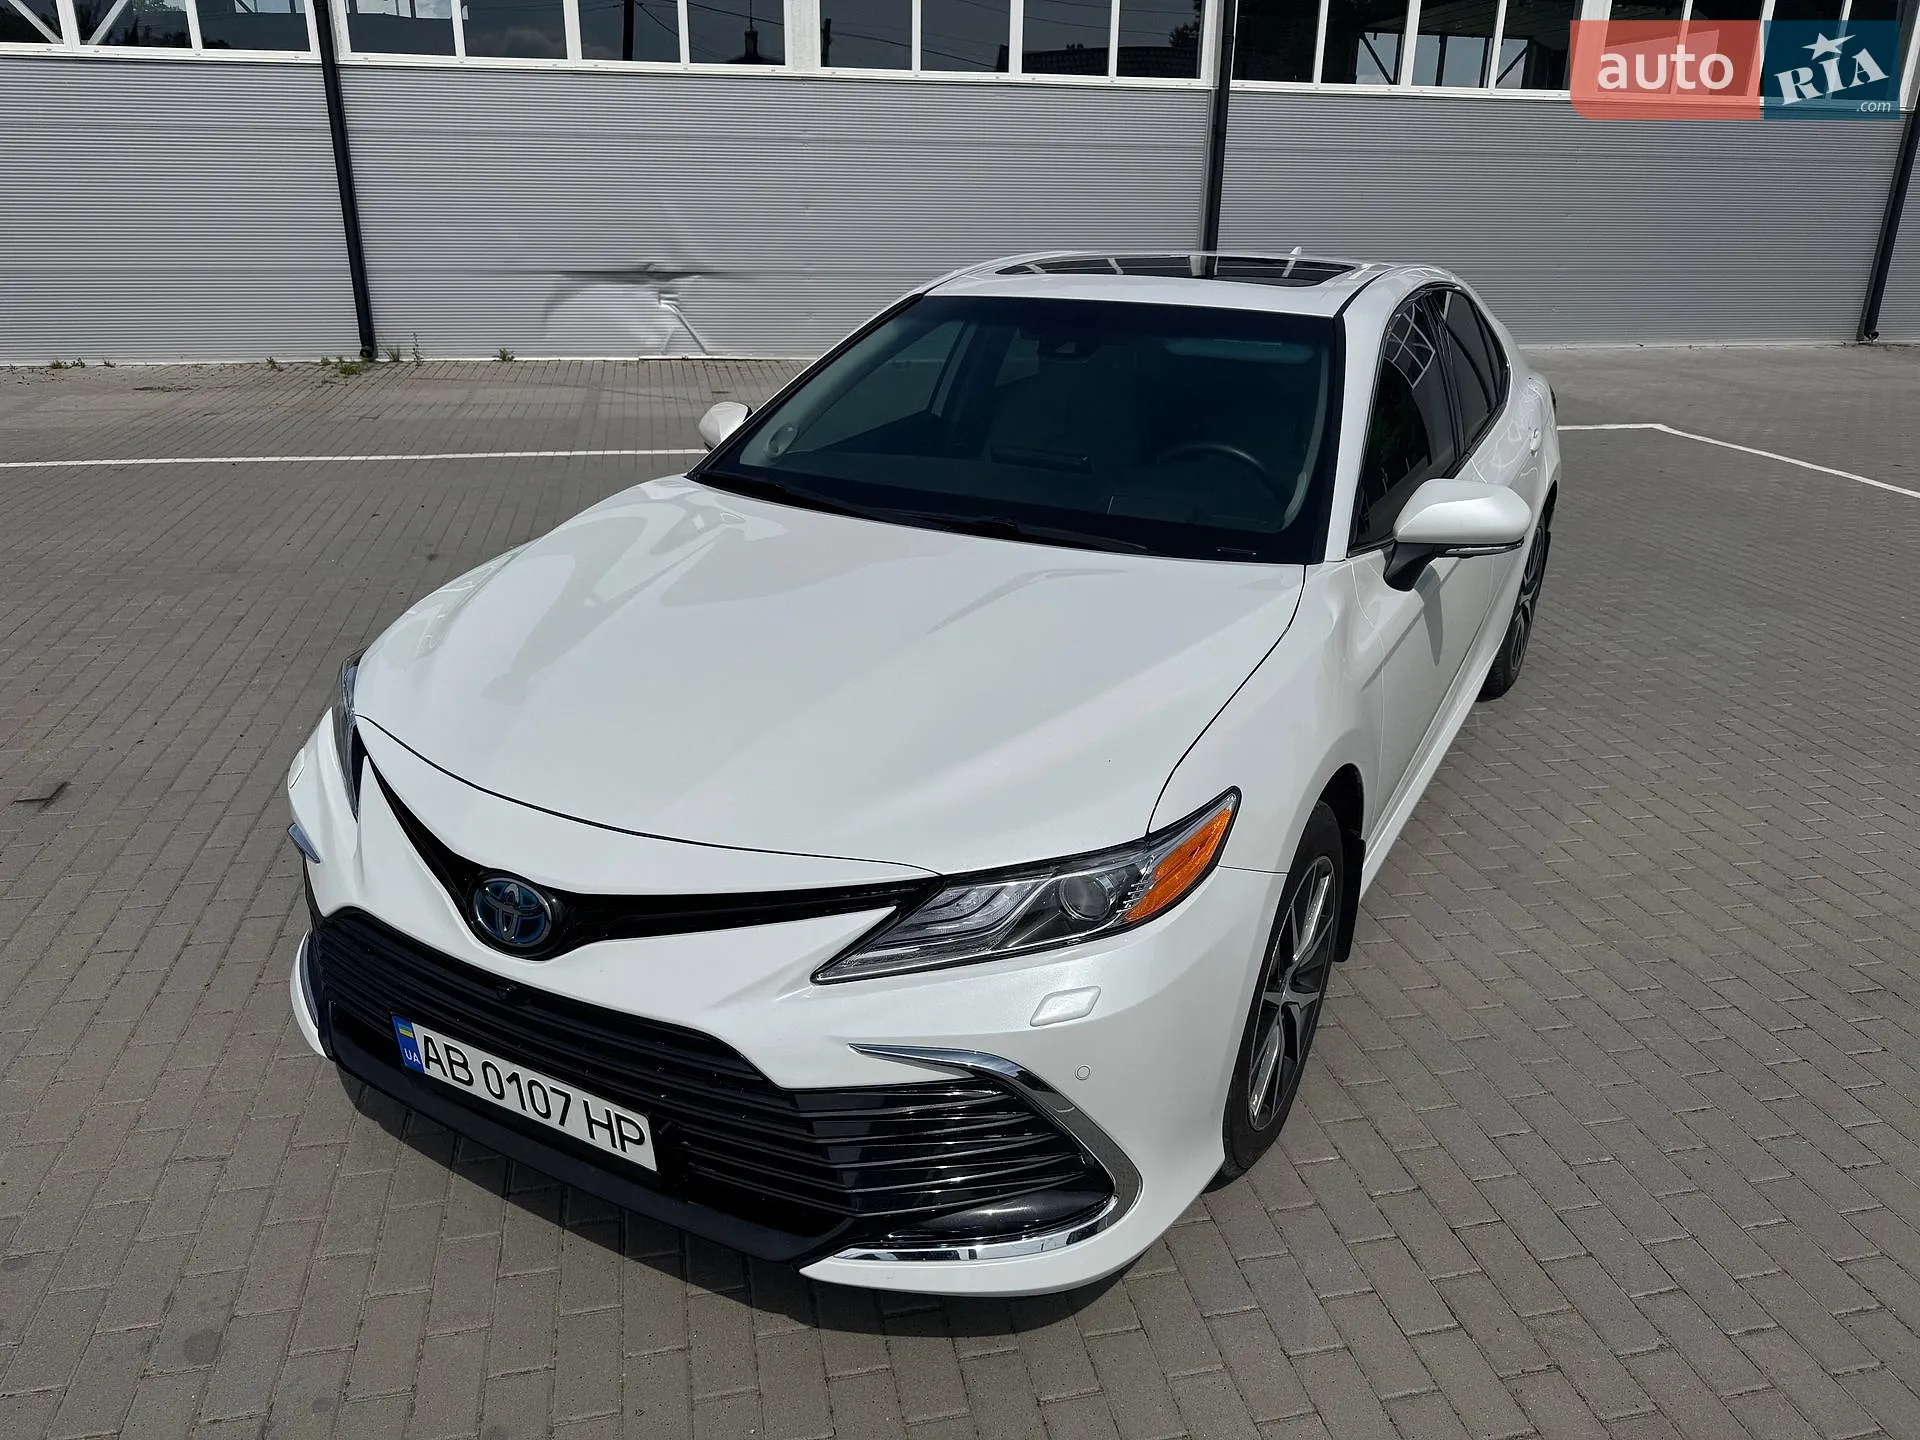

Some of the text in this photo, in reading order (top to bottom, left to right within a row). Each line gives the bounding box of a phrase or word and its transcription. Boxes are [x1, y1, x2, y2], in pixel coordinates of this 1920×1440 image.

[404, 1048, 421, 1064] UA
[423, 1034, 645, 1153] AB 0107 HP
